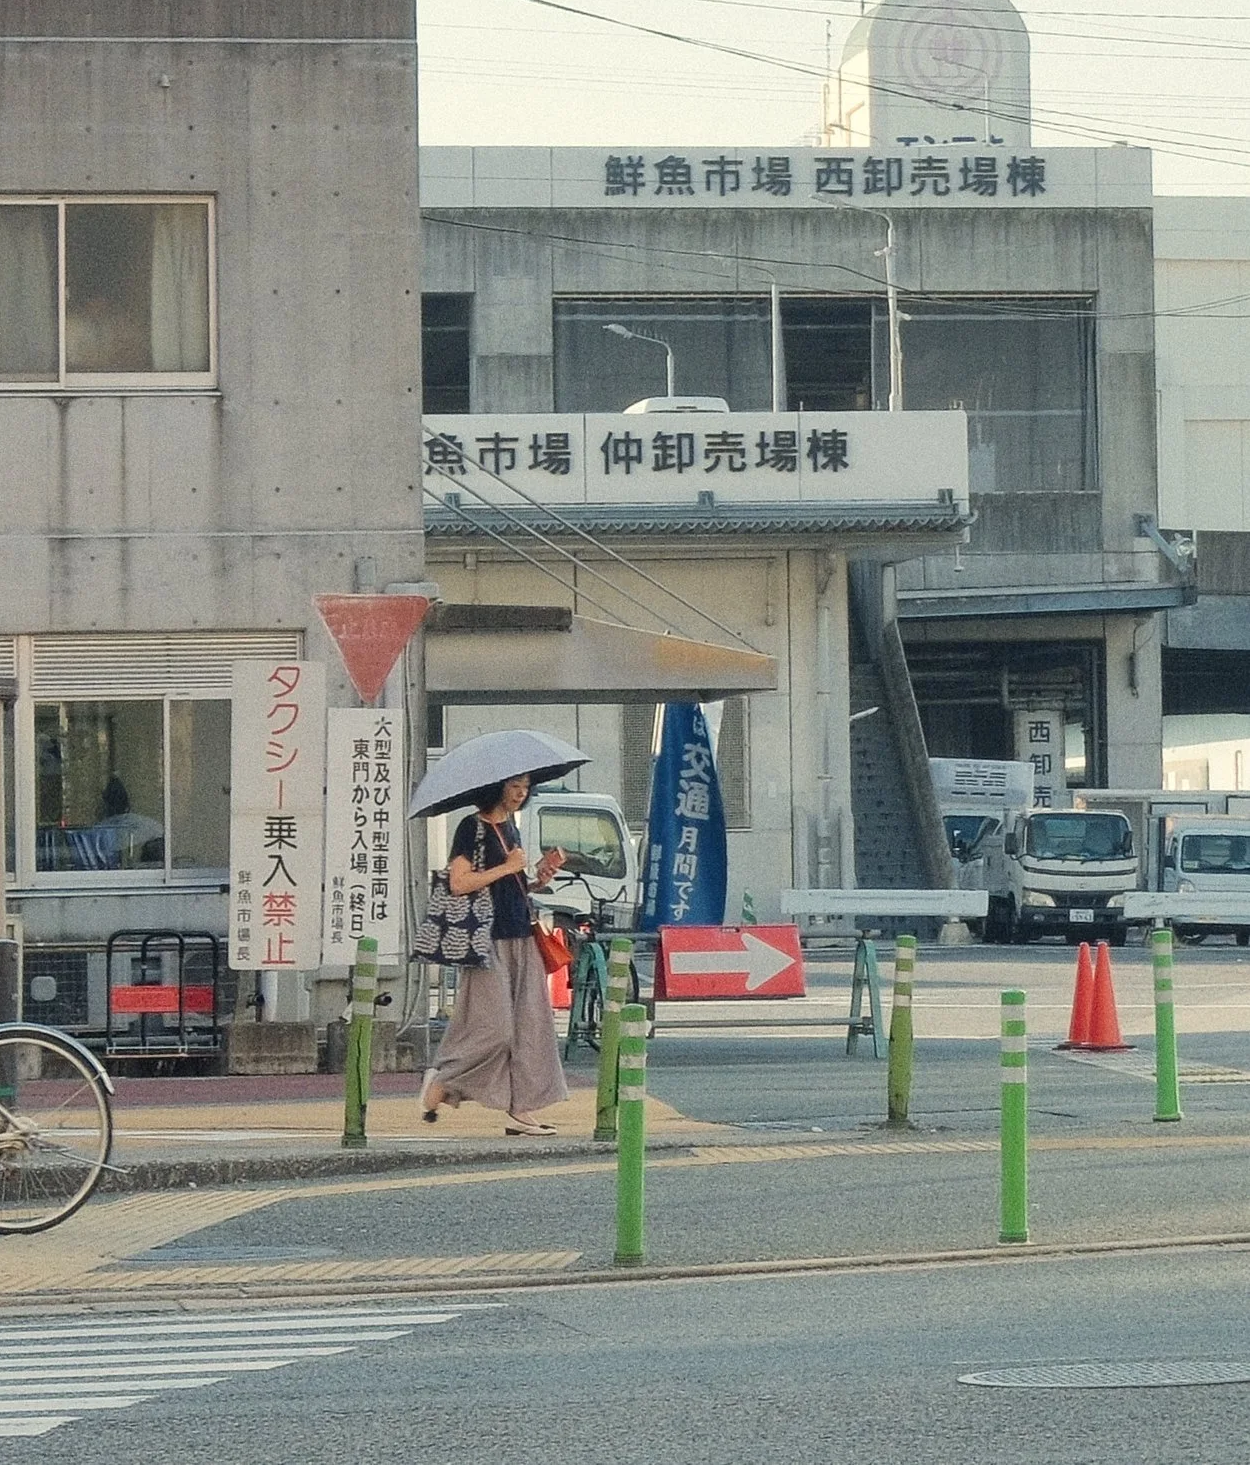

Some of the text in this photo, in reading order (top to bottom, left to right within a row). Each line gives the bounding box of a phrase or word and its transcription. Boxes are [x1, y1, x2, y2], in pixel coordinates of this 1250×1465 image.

[604, 154, 1047, 198] 鮮魚市場 西卸売場棟
[423, 429, 851, 475] 魚市場 仲卸売場棟
[261, 665, 300, 965] タクシー乗入禁止
[370, 716, 392, 921] 大型及び中型車両は
